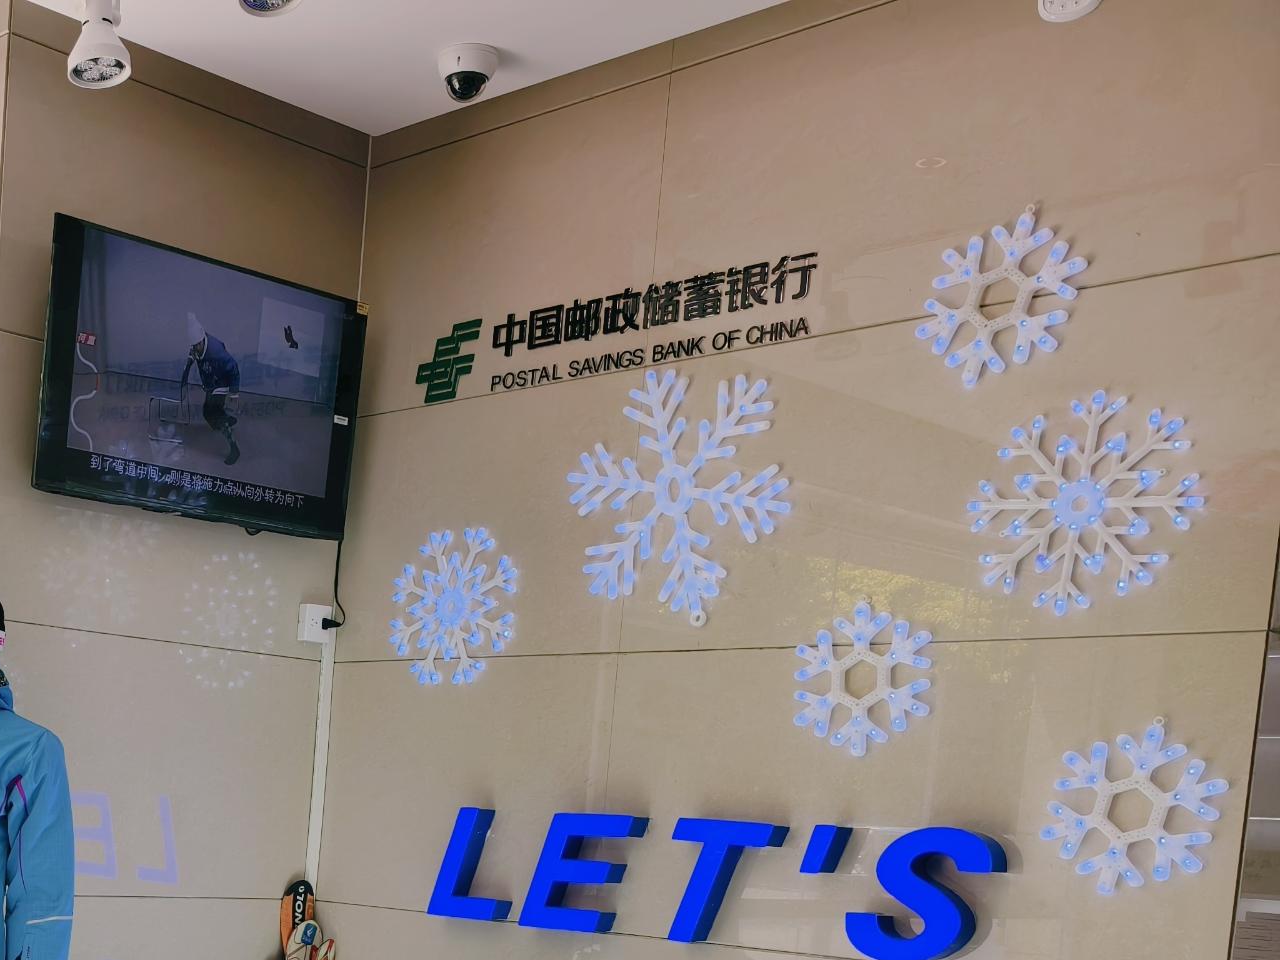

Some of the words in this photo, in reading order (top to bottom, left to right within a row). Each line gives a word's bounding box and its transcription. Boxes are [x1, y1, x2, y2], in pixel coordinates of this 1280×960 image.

[491, 252, 818, 357] 中国邮政储蓄银行
[490, 364, 563, 391] POSTAL
[568, 348, 645, 378] SAVINGS
[651, 336, 706, 363] BANK
[711, 329, 742, 351] OF
[745, 317, 810, 345] CHINA
